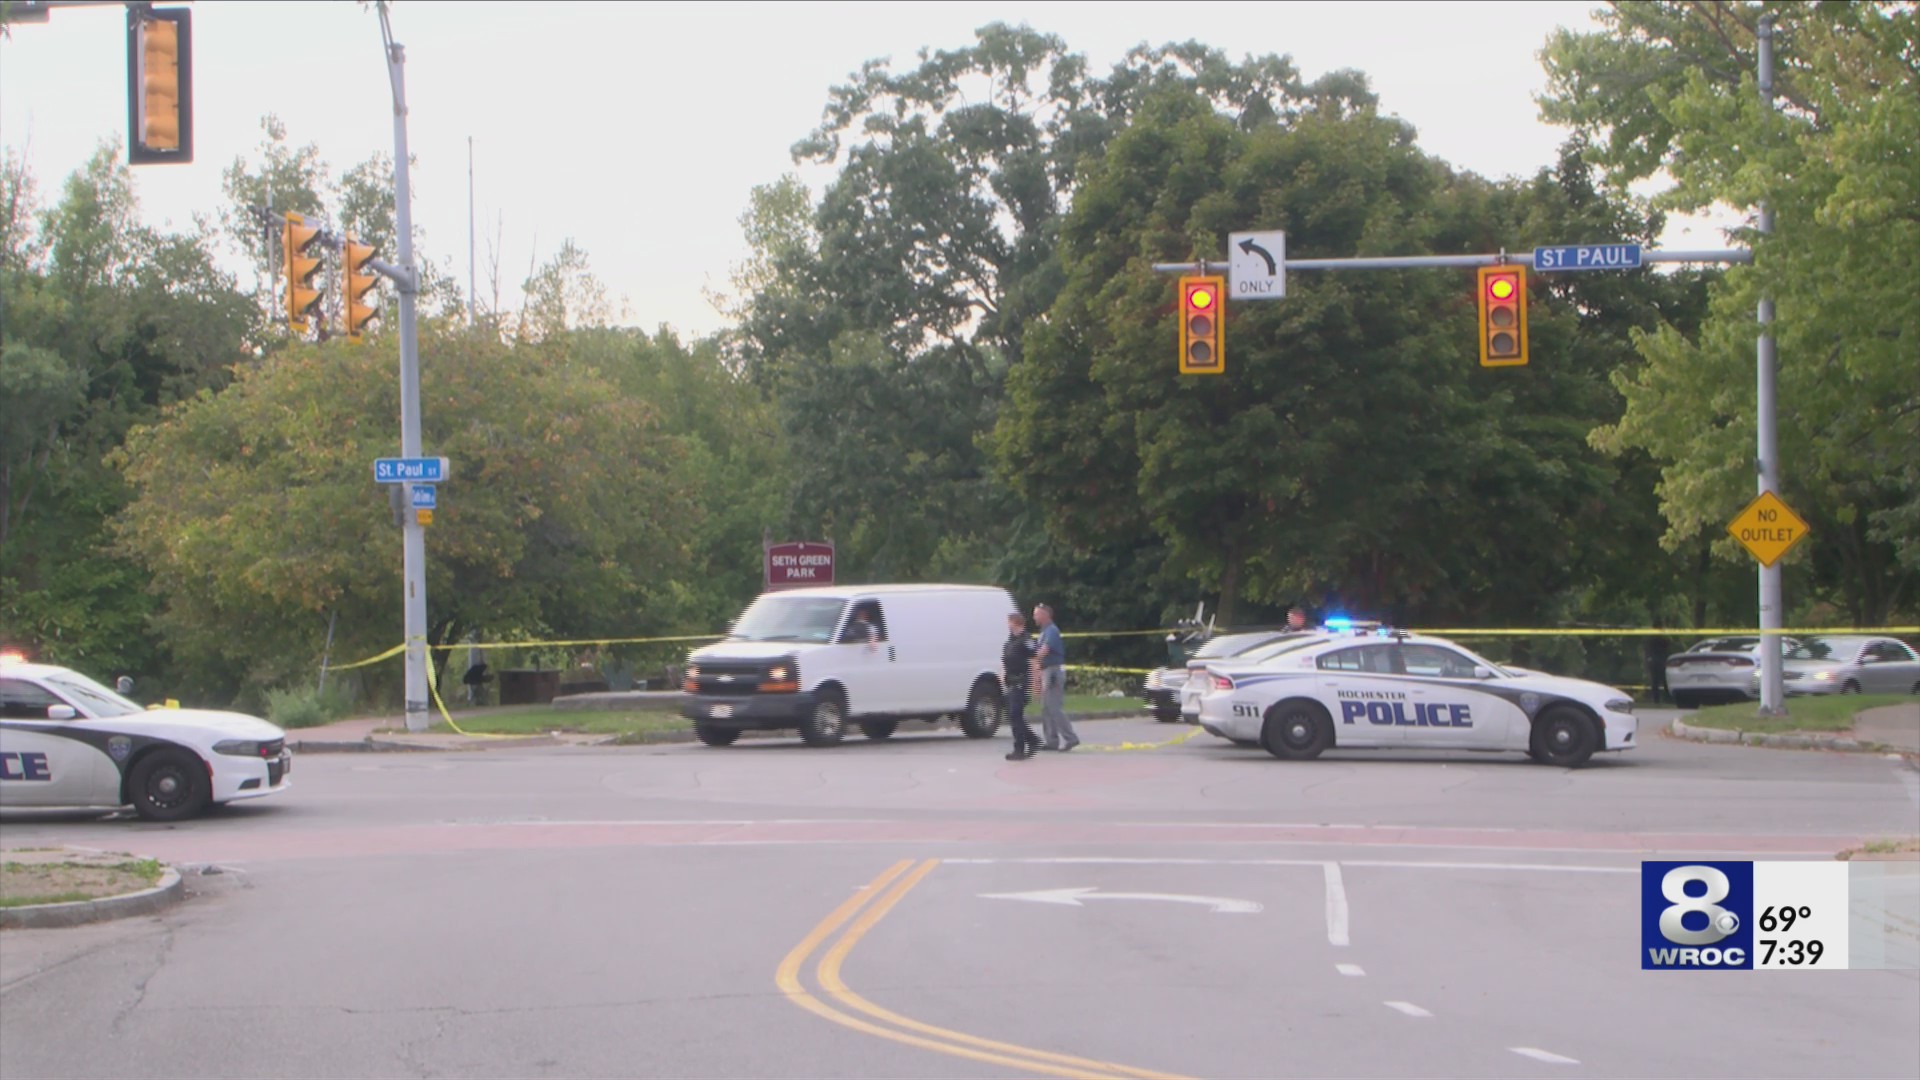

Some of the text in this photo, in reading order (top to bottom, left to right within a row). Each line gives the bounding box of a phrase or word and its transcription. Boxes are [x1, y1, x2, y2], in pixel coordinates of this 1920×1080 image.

[1542, 247, 1633, 266] ST PAUL
[1239, 280, 1273, 293] ONLY
[378, 462, 394, 477] St.
[396, 462, 423, 477] Paul
[1758, 509, 1777, 522] NO
[1741, 528, 1792, 542] OUTLET
[772, 555, 831, 566] SETH GREEN
[786, 567, 816, 578] PARK
[1337, 690, 1406, 700] ROCHESTER
[1232, 704, 1260, 718] 911
[1340, 701, 1473, 728] POLICE
